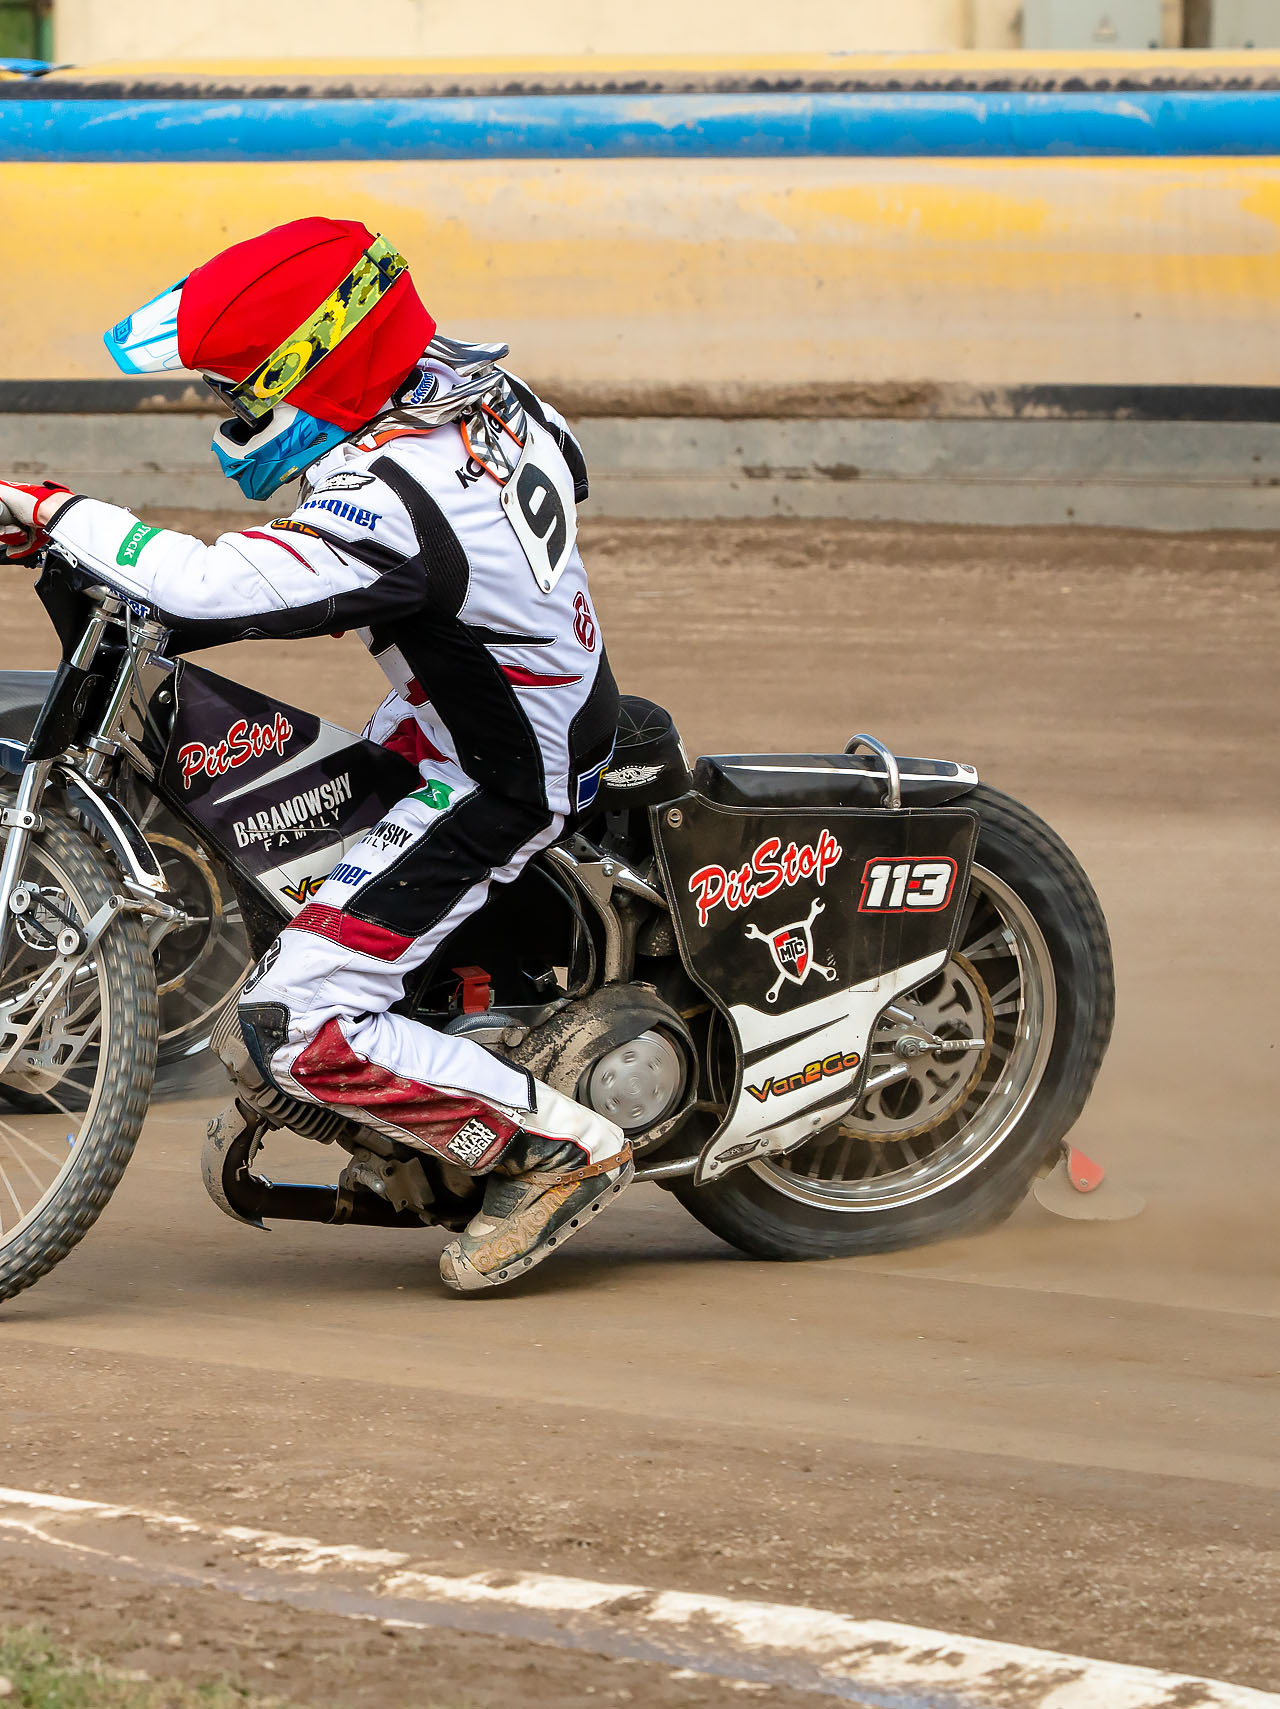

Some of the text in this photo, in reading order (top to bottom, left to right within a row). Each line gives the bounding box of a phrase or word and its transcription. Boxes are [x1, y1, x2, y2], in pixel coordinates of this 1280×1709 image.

[519, 463, 567, 573] 9
[233, 772, 352, 848] BARANOWSKY
[264, 808, 340, 851] FAMILY
[687, 828, 842, 927] PitStop
[865, 862, 953, 908] 113
